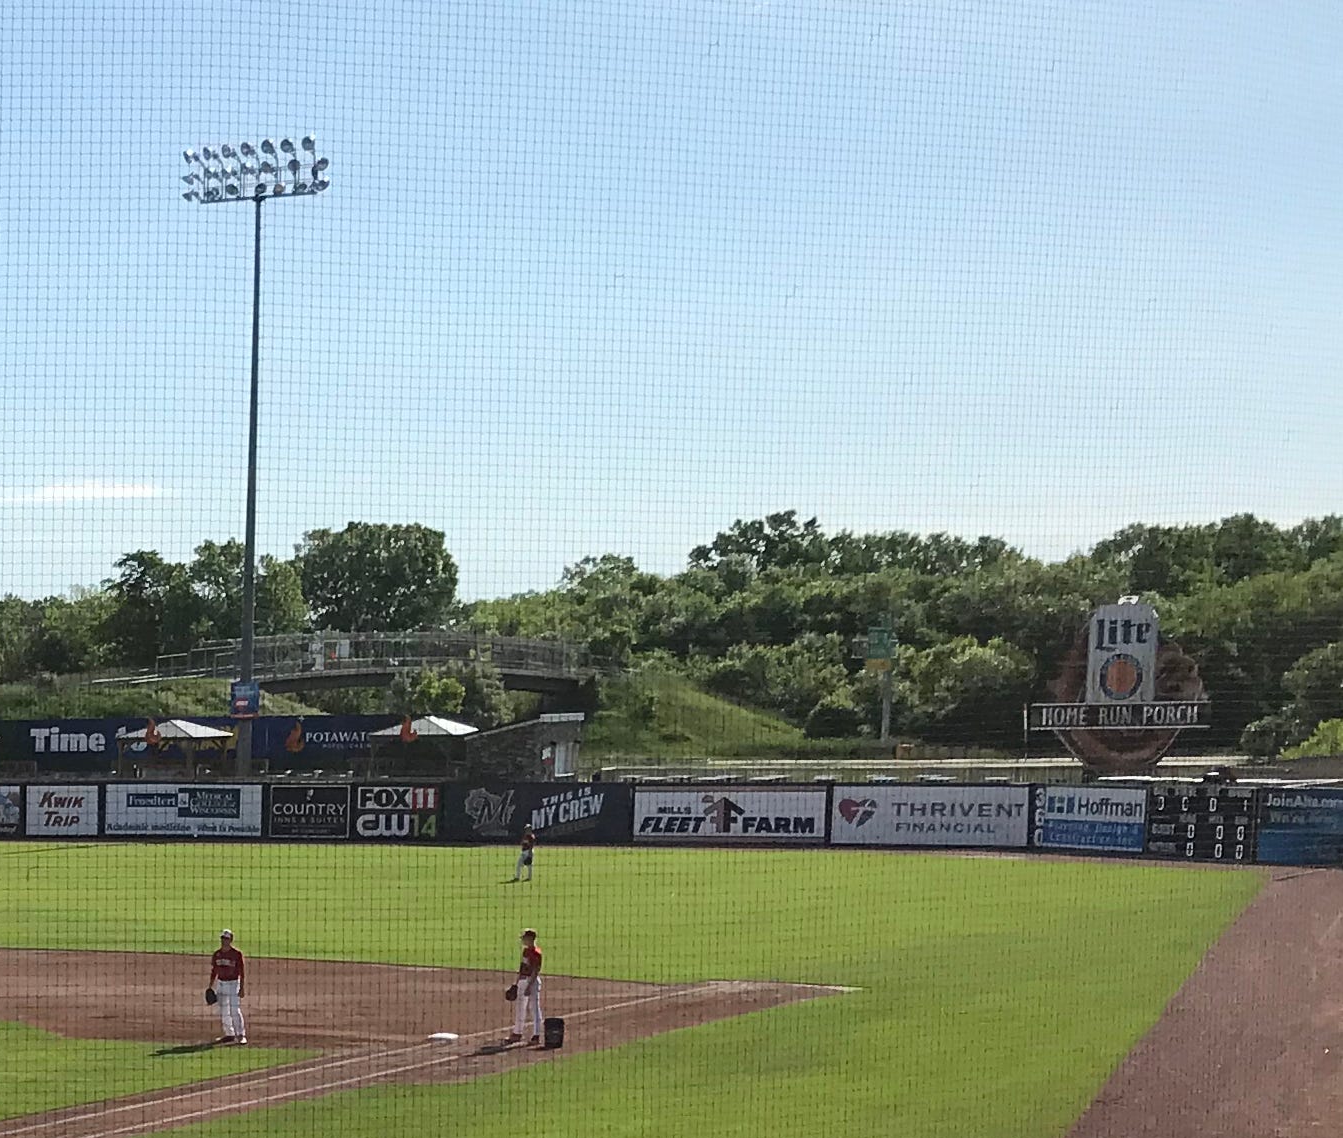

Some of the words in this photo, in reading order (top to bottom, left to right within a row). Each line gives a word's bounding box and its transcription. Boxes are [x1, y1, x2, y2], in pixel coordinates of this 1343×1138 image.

[1095, 619, 1152, 650] Lite
[1042, 707, 1087, 726] HOME
[1098, 705, 1133, 725] RUN
[1141, 705, 1199, 725] PORCH
[30, 726, 106, 753] Time
[39, 791, 85, 808] KWIK
[358, 787, 411, 809] FOX
[413, 788, 435, 808] 11
[542, 791, 572, 806] THIS
[578, 786, 592, 797] IS
[531, 804, 556, 830] MY
[558, 793, 605, 823] CREW
[658, 806, 692, 815] MILLS
[892, 801, 1025, 819] THRIVENT
[1078, 797, 1144, 817] Hoffman
[44, 811, 80, 827] TRIP
[410, 814, 437, 837] 14
[638, 816, 706, 833] FLEET
[742, 816, 815, 834] FARM
[895, 821, 996, 834] FINANCIAL
